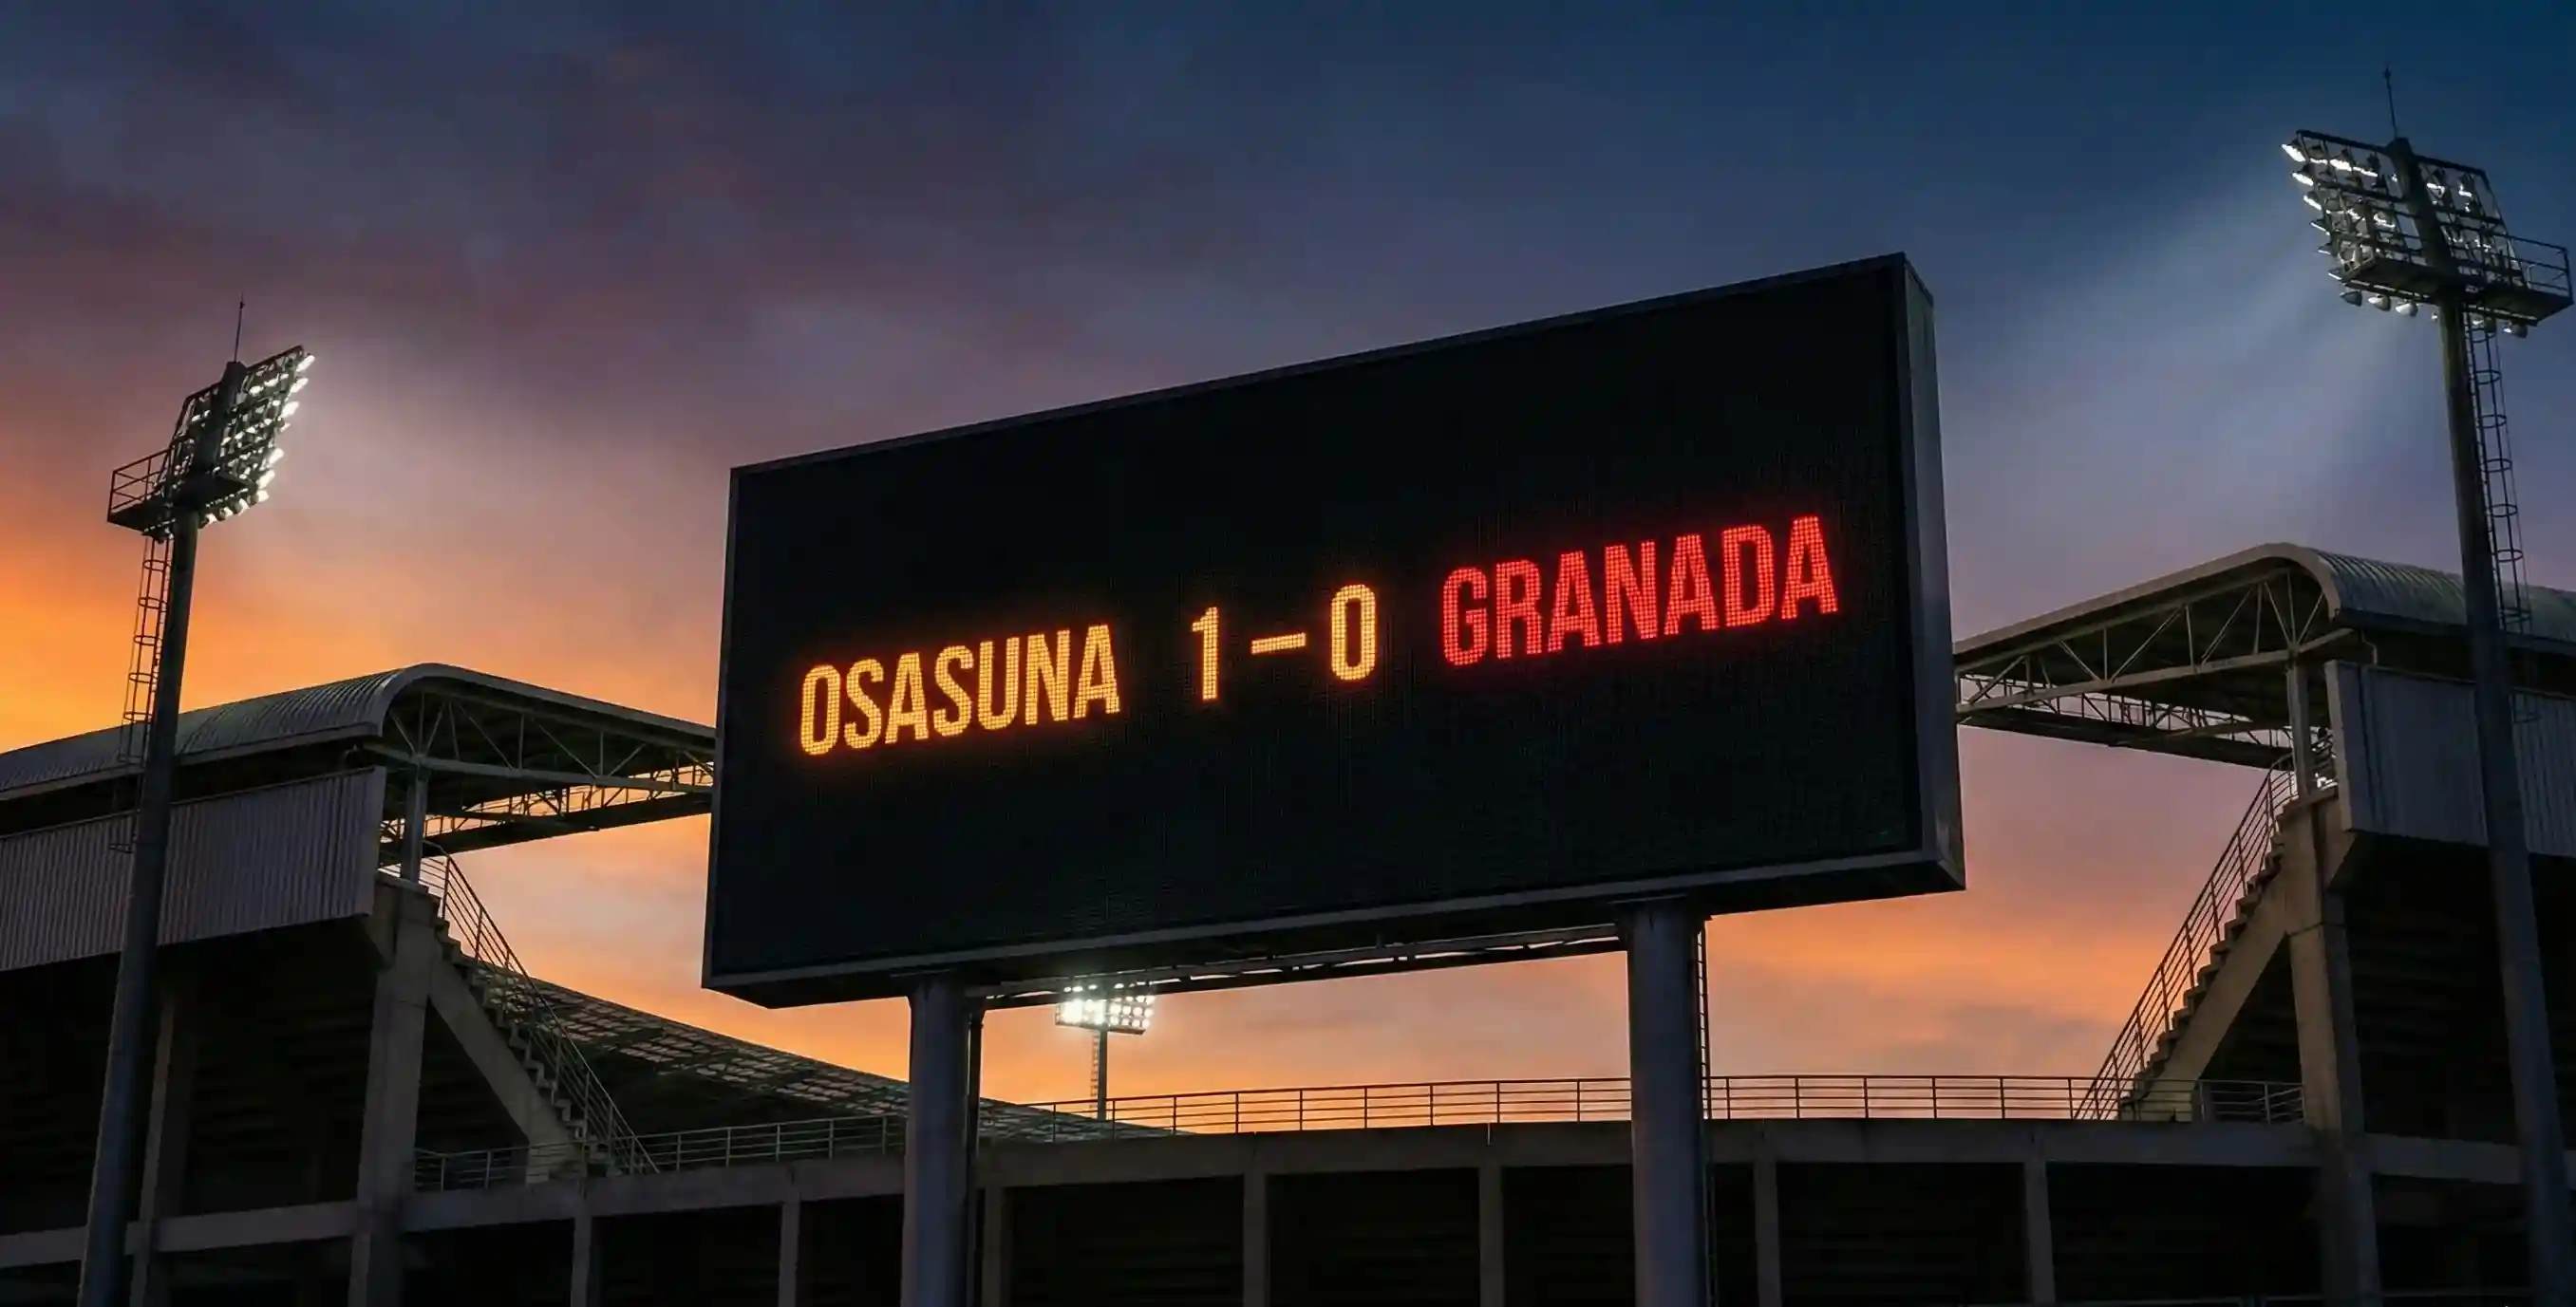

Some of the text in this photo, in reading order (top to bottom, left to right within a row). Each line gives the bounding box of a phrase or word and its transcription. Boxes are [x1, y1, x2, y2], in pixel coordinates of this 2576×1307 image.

[799, 623, 1121, 756] OSASUNA
[1191, 606, 1220, 701] 1
[1329, 583, 1379, 682] 0
[1440, 514, 1838, 666] GRANADA
